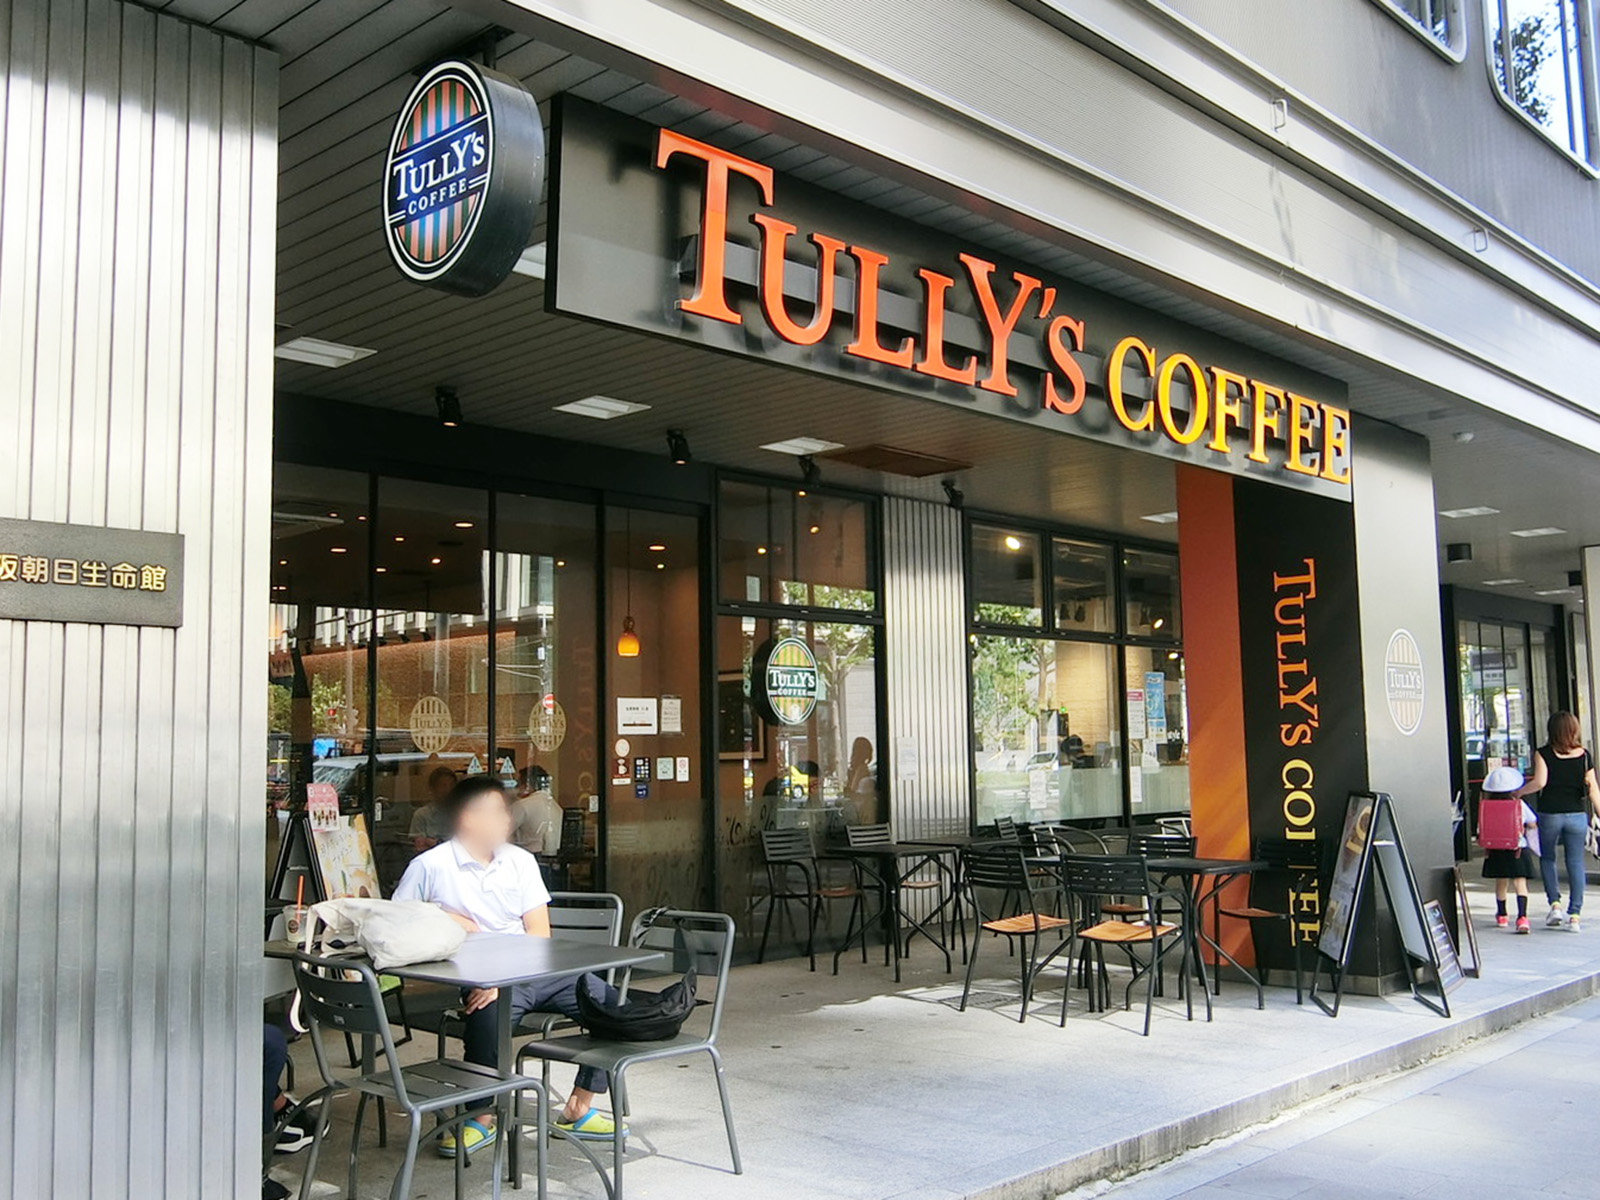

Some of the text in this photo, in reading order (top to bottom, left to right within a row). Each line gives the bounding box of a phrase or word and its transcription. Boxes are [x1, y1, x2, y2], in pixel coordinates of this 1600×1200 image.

[393, 131, 486, 201] TULLY'S
[408, 177, 467, 216] COFFEE
[655, 127, 1351, 485] TULLY'S COFFEE
[769, 669, 815, 688] TULLY'S
[777, 688, 807, 696] COFFEE
[1272, 557, 1321, 947] TULLY'S COEE
